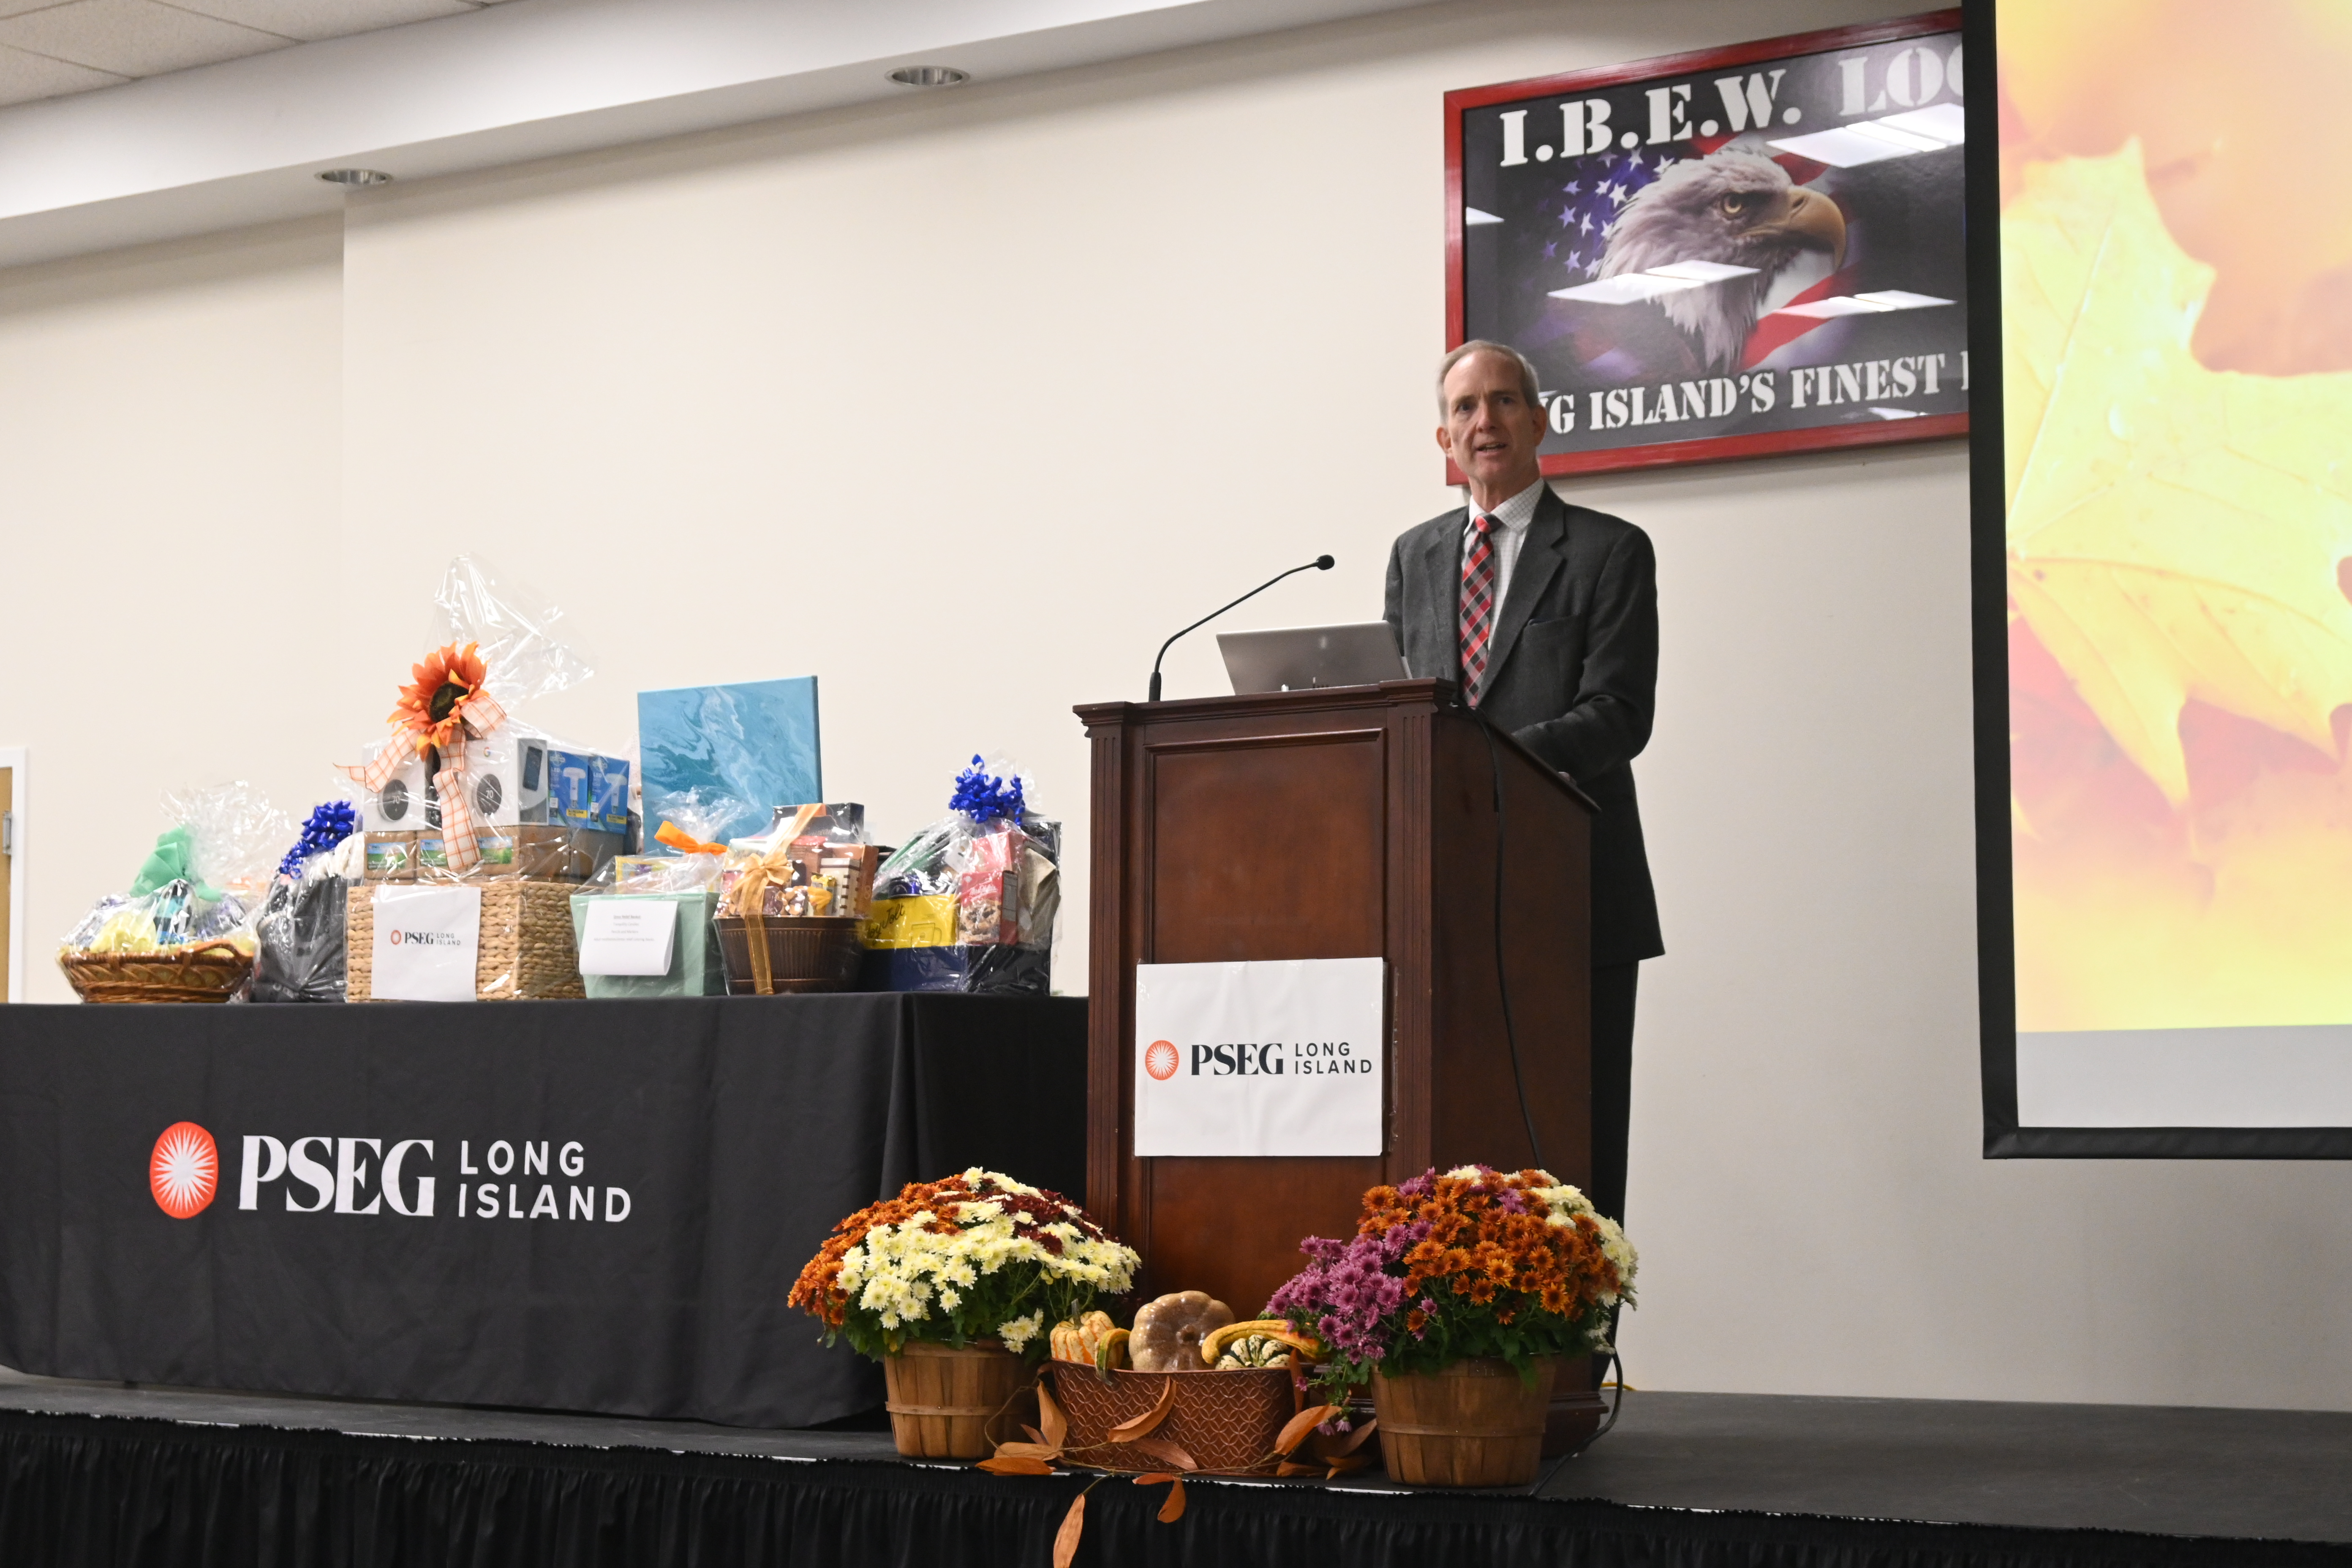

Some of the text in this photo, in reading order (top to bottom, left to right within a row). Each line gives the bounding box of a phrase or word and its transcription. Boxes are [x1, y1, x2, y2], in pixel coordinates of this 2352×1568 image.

[1500, 68, 1802, 167] I.B.E.W.
[1589, 372, 1774, 430] ISLAND'S
[1790, 353, 1945, 409] FINEST
[392, 795, 400, 804] 70
[486, 790, 494, 798] 70
[405, 932, 433, 945] PSEG
[1191, 1043, 1284, 1075] PSEG
[1295, 1042, 1350, 1057] LONG
[1295, 1059, 1372, 1075] ISLAND
[461, 1140, 585, 1177] LONG
[239, 1135, 435, 1217] PSEG
[458, 1183, 631, 1222] ISLAND
